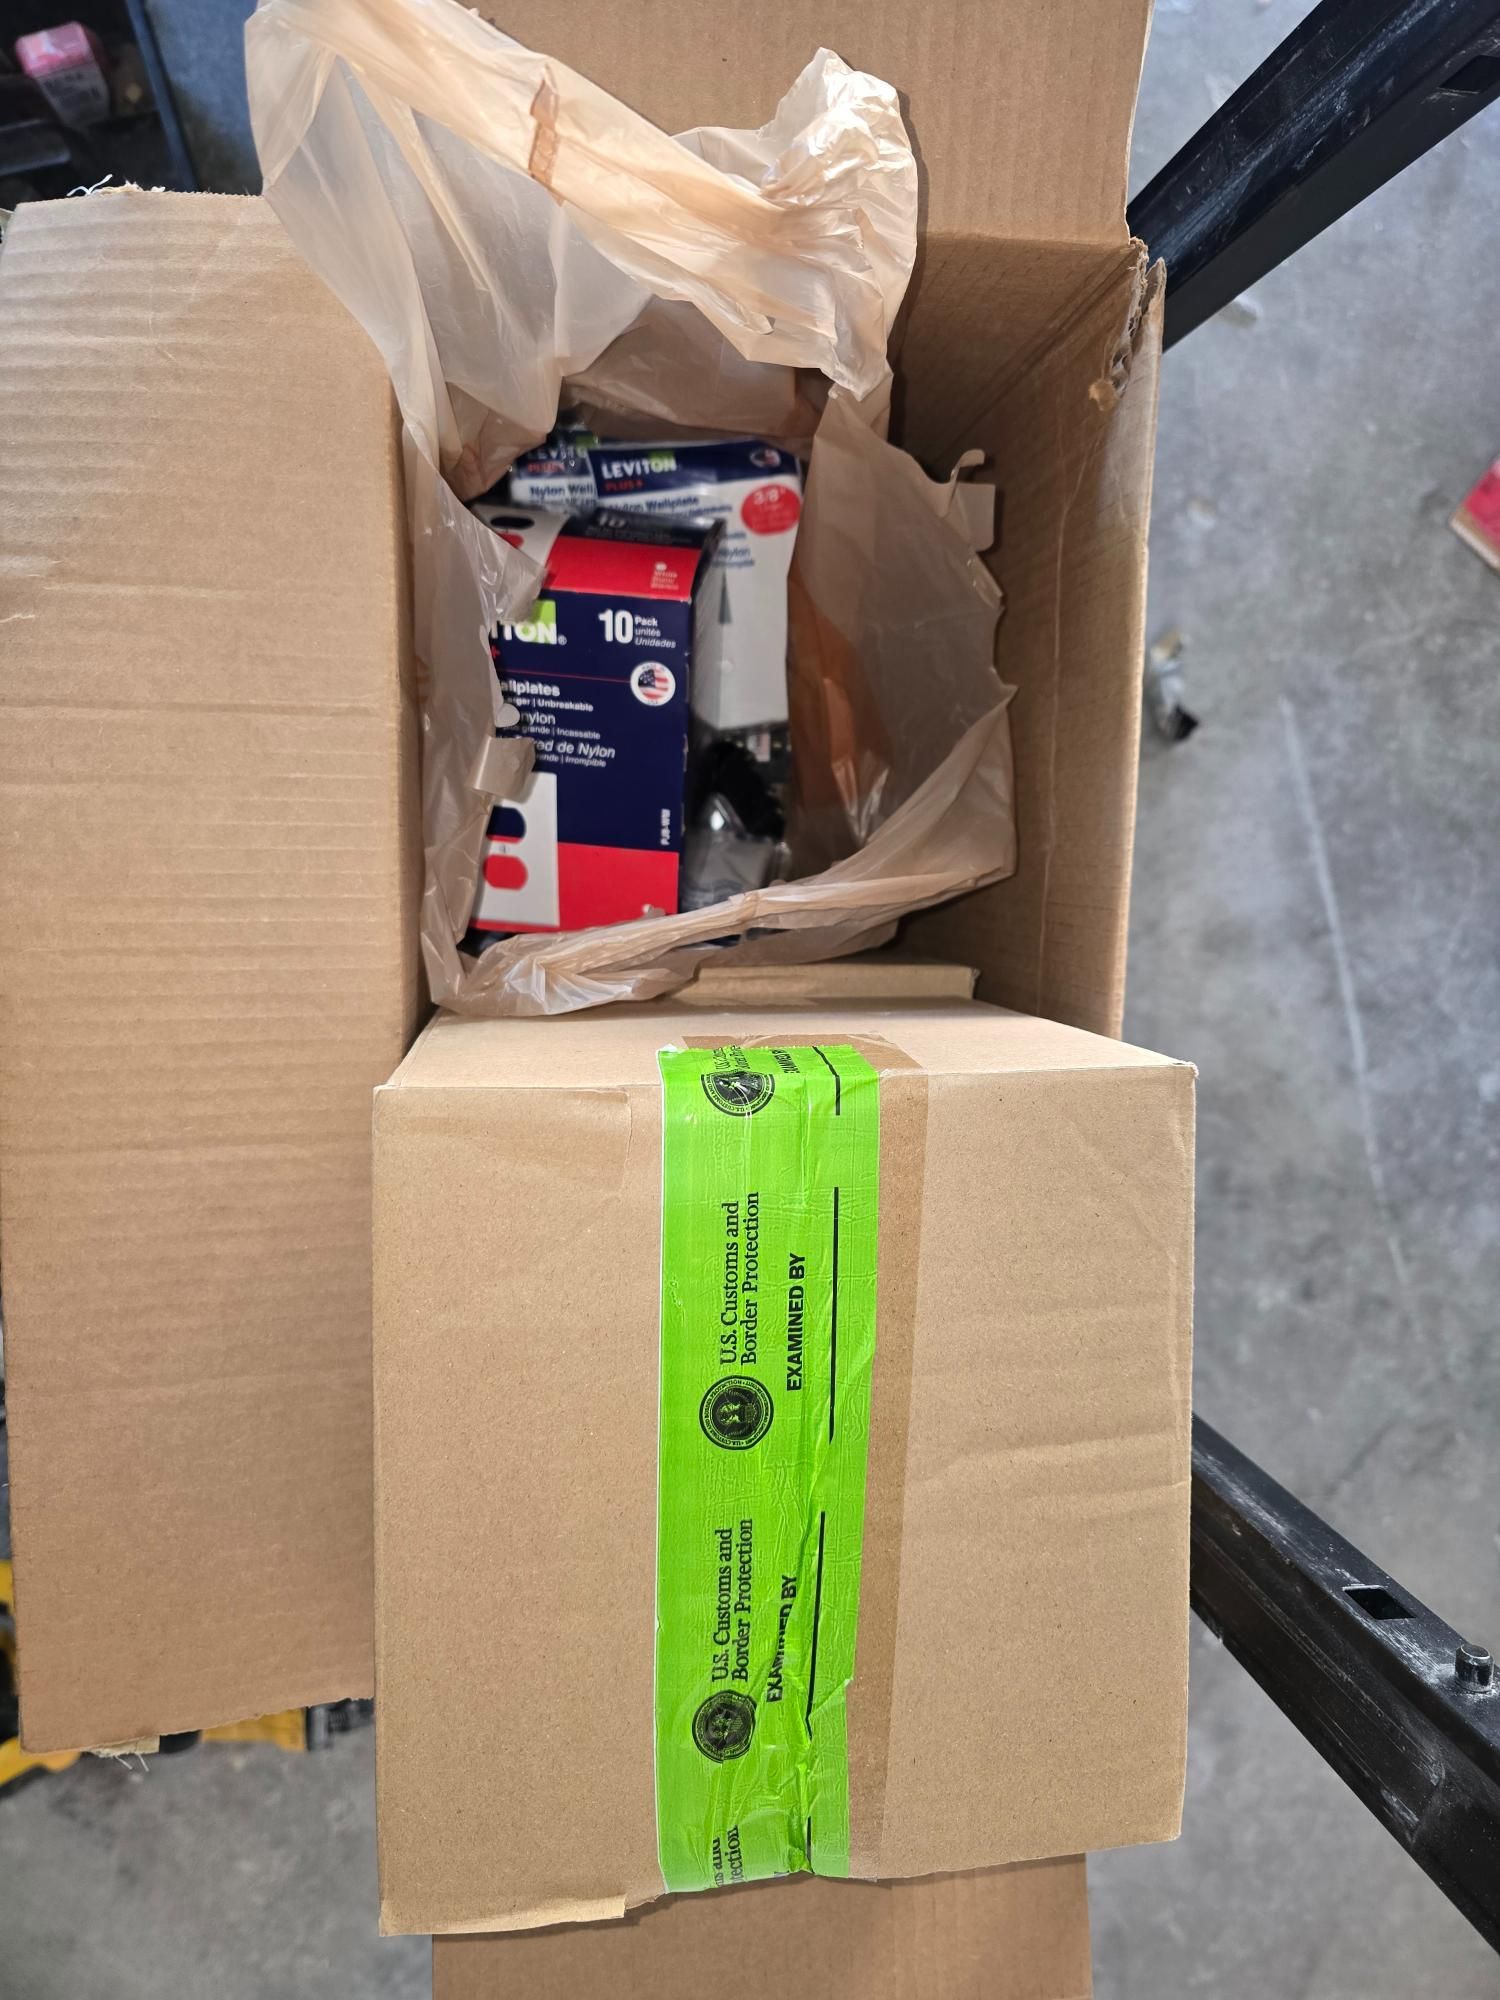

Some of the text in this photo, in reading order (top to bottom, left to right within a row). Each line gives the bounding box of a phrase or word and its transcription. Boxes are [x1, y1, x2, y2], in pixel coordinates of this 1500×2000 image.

[602, 454, 676, 479] LEVITON
[491, 620, 557, 645] ITON
[599, 609, 658, 644] 10 Pack
[635, 637, 677, 649] Unidades
[499, 680, 560, 697] allplates
[537, 698, 594, 712] Unbreakable
[521, 711, 556, 725] nylon
[556, 728, 601, 740] Incassable
[557, 742, 575, 754] de
[578, 743, 616, 759] Nylon
[742, 1192, 759, 1293] Protection
[720, 1201, 739, 1364] U.S. Customs and
[741, 1297, 759, 1365] Border
[786, 1253, 806, 1392] EXAMINED BY
[780, 1575, 797, 1600] BY
[712, 1529, 732, 1682] U.S. Customs and
[733, 1519, 752, 1682] Border Protection
[724, 1824, 745, 1883] tection
